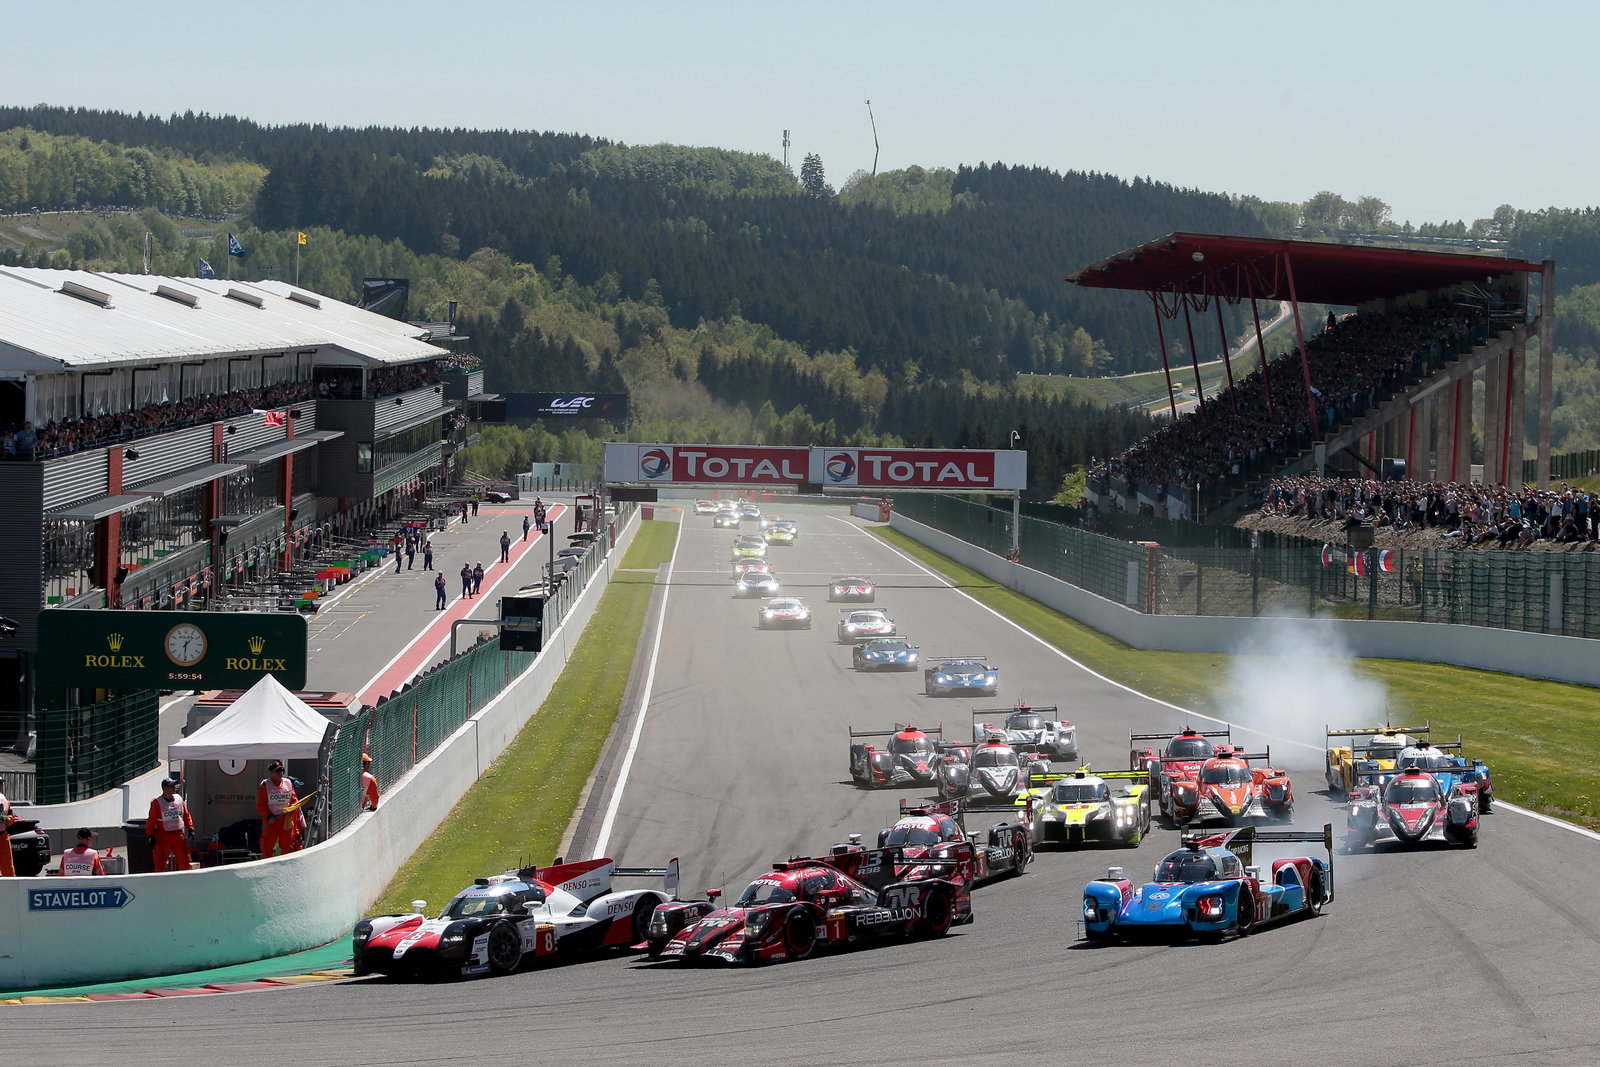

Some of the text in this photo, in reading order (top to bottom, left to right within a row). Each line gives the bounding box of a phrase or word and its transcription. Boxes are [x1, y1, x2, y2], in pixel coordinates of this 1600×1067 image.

[551, 396, 595, 408] WEC
[678, 451, 804, 480] TOTAL
[864, 455, 989, 482] TOTAL
[85, 655, 145, 668] ROLEX
[226, 658, 286, 671] ROLEX
[168, 672, 202, 680] 5:59:54
[65, 863, 91, 871] COURSE
[563, 880, 587, 891] DENSO
[34, 891, 106, 907] STAVELOT
[608, 901, 634, 915] DENSO
[856, 907, 922, 927] REBELLION
[834, 921, 840, 939] 1
[525, 939, 533, 947] P1
[545, 933, 553, 951] 8
